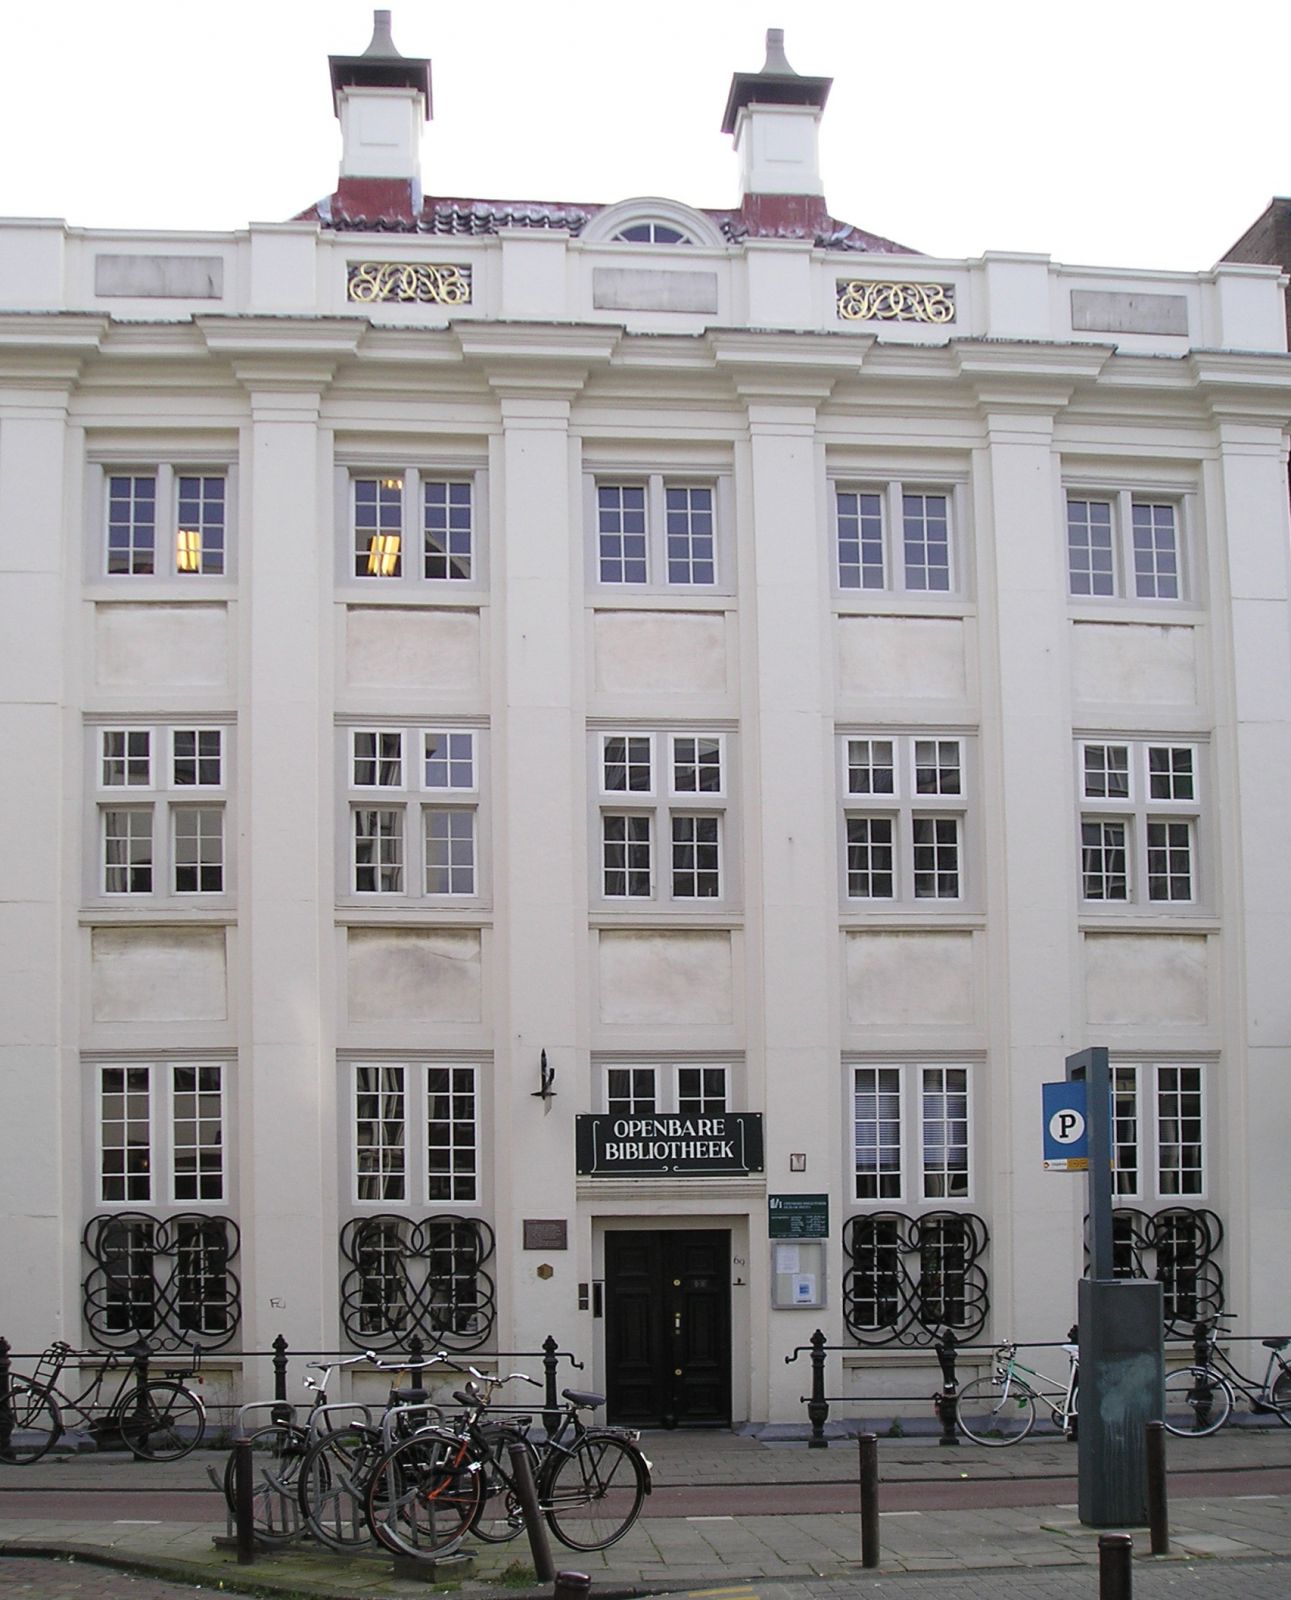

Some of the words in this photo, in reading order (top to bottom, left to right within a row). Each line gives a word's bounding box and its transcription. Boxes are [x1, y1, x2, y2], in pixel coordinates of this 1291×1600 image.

[613, 1118, 726, 1138] OPENBARE
[1059, 1114, 1076, 1138] P
[605, 1140, 735, 1160] BIBLIOTHEEK
